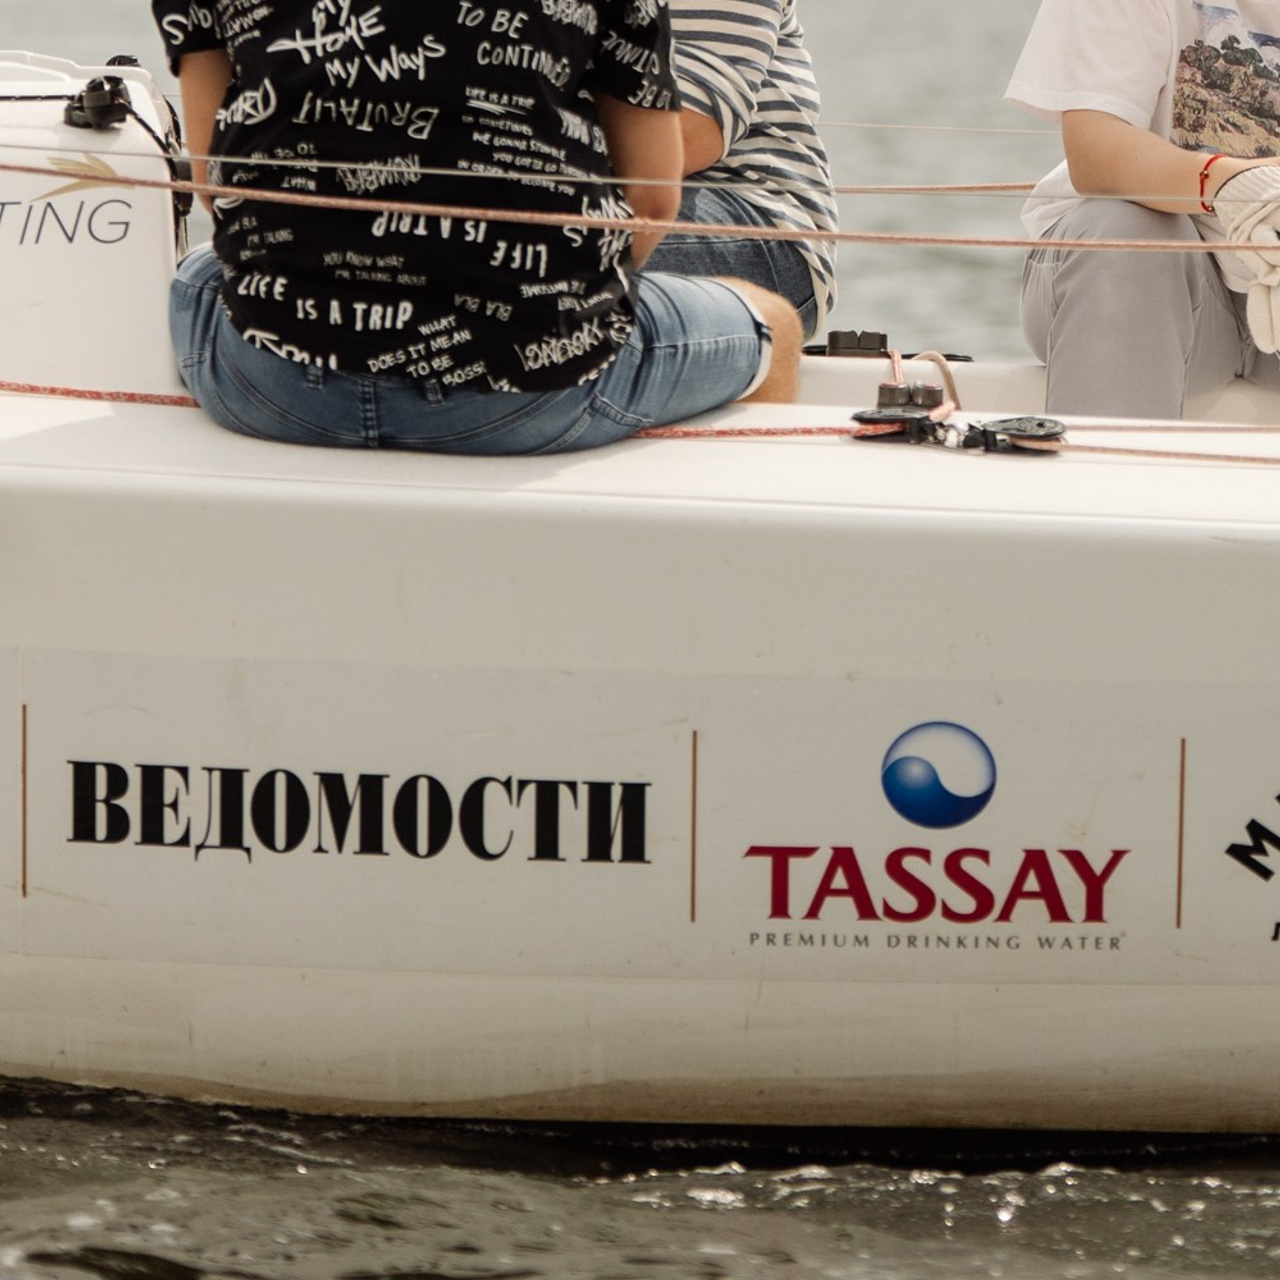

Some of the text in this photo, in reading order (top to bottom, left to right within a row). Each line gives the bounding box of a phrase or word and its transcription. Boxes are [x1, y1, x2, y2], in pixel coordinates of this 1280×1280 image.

[456, 0, 486, 27] TO
[490, 8, 529, 39] BE
[371, 210, 548, 279] LIFE IS A TRIP
[237, 273, 414, 332] LIFE IS A TRIP
[418, 314, 457, 337] WHAT
[367, 329, 473, 374] DOES IT MEAN
[405, 355, 455, 379] TO BE
[66, 759, 653, 865] ВЕДОМОСТИ
[742, 845, 1132, 925] TASSAY
[749, 931, 871, 950] PREMIUM
[886, 933, 1022, 951] DRINKING
